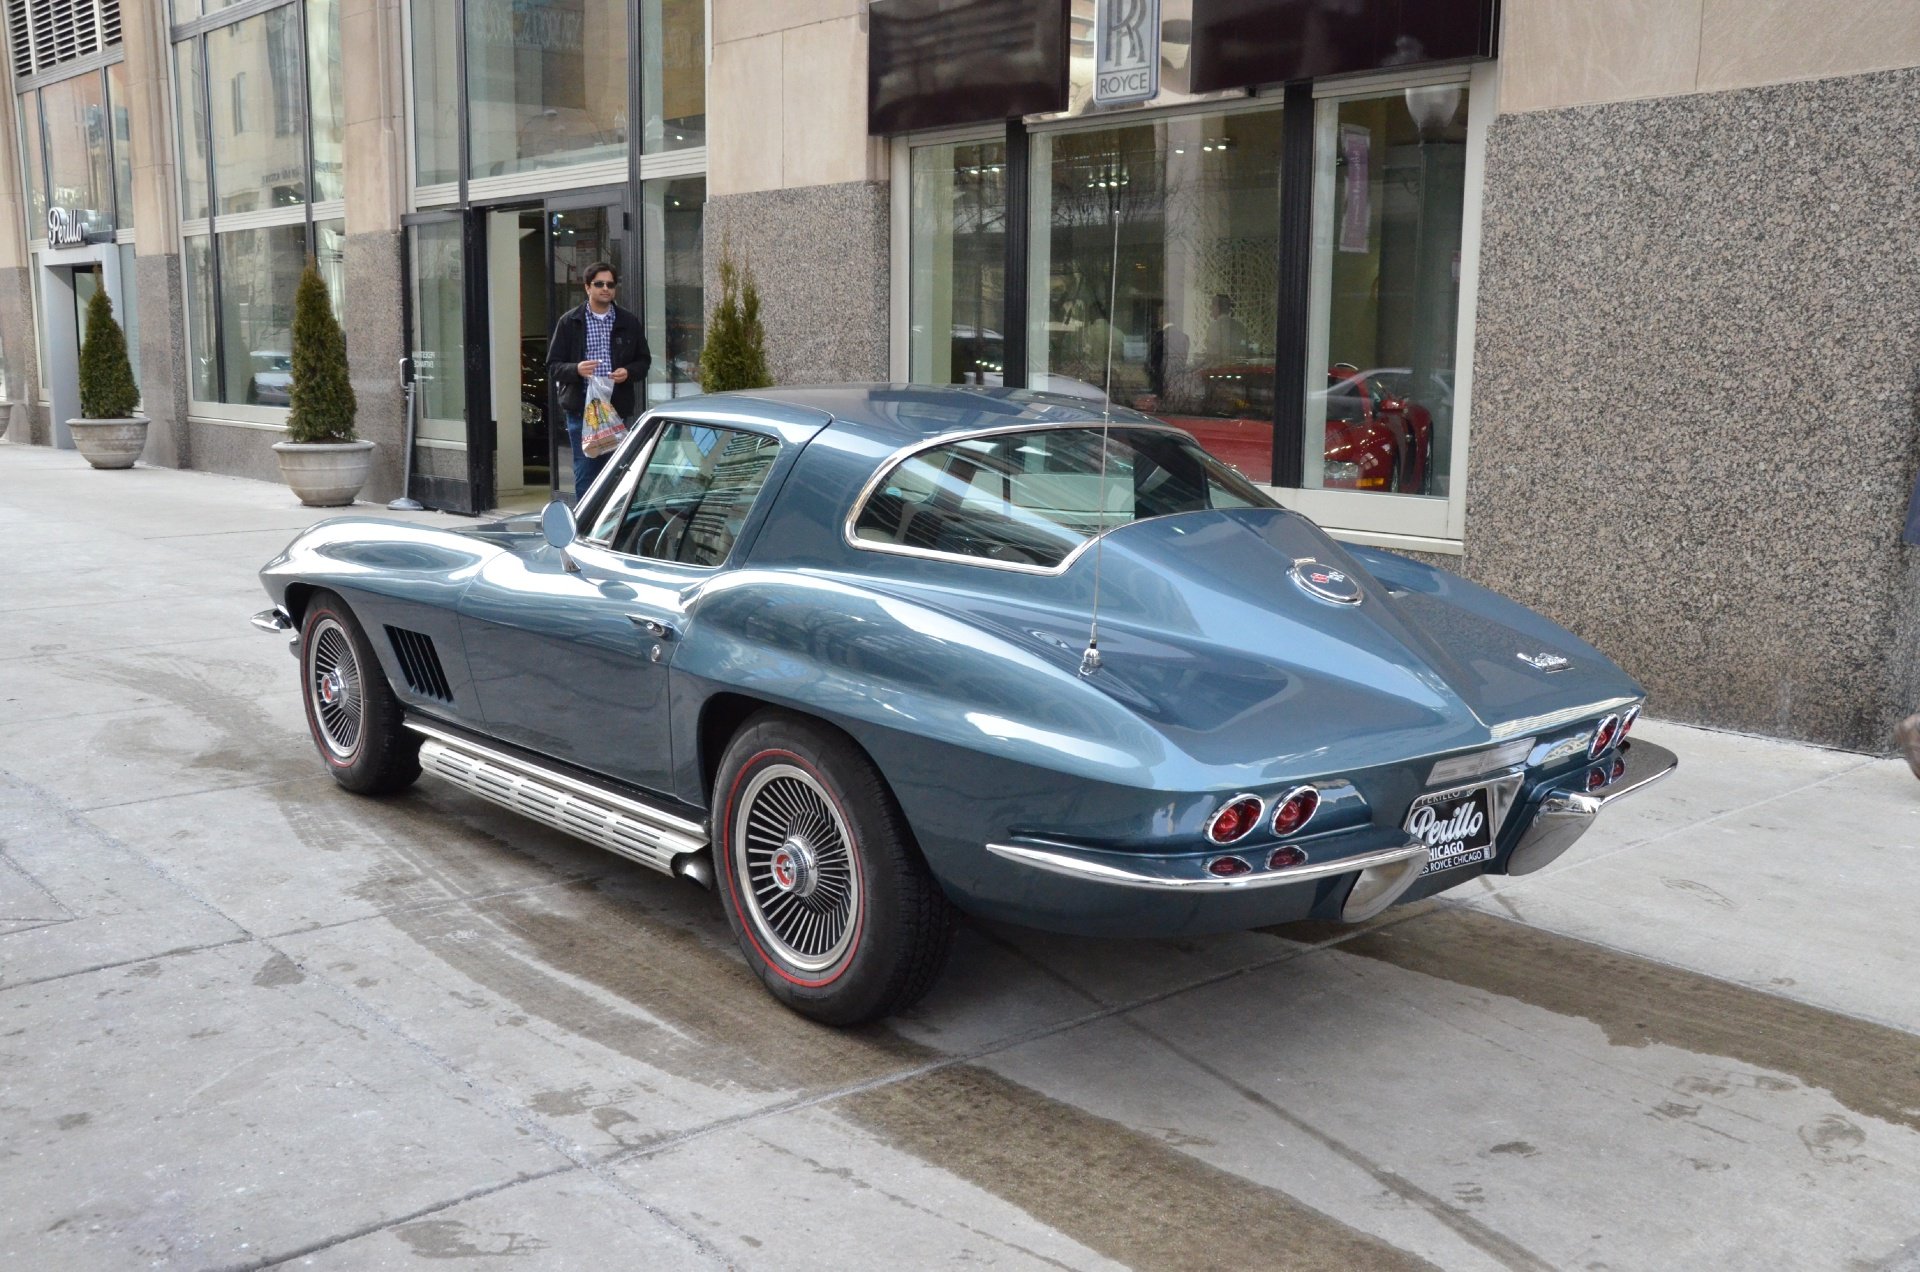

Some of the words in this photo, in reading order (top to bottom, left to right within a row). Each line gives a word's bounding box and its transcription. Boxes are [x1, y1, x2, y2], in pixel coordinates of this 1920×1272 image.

[1100, 72, 1147, 95] ROYCE
[48, 207, 83, 245] Perillo
[1409, 801, 1483, 846] Perillo
[1428, 841, 1464, 862] HICAGO
[1430, 859, 1452, 871] ROYCE
[1453, 850, 1482, 865] CHICAGO
